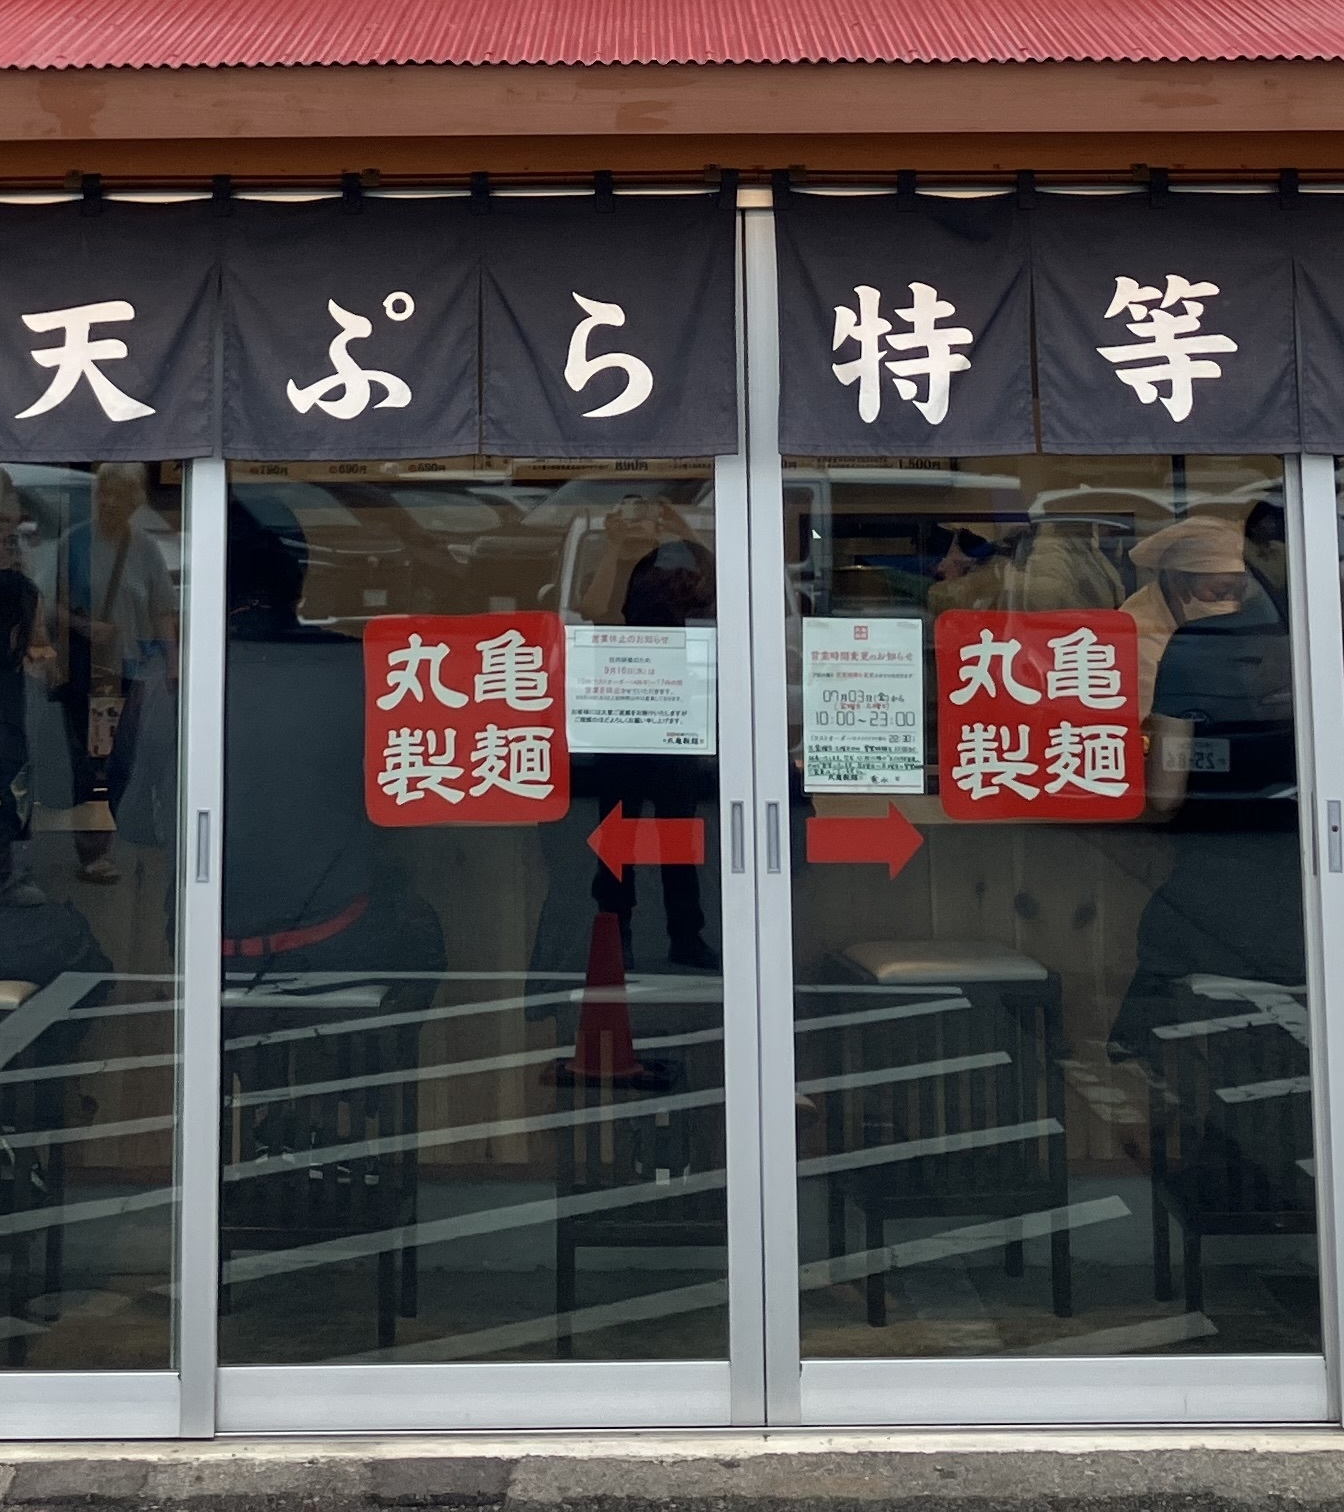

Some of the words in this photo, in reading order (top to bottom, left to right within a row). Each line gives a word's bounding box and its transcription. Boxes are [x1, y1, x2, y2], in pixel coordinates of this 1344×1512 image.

[376, 629, 554, 711] 丸亀
[949, 627, 1127, 709] 丸亀
[377, 723, 555, 805] 製麺
[952, 721, 1130, 800] 製麺
